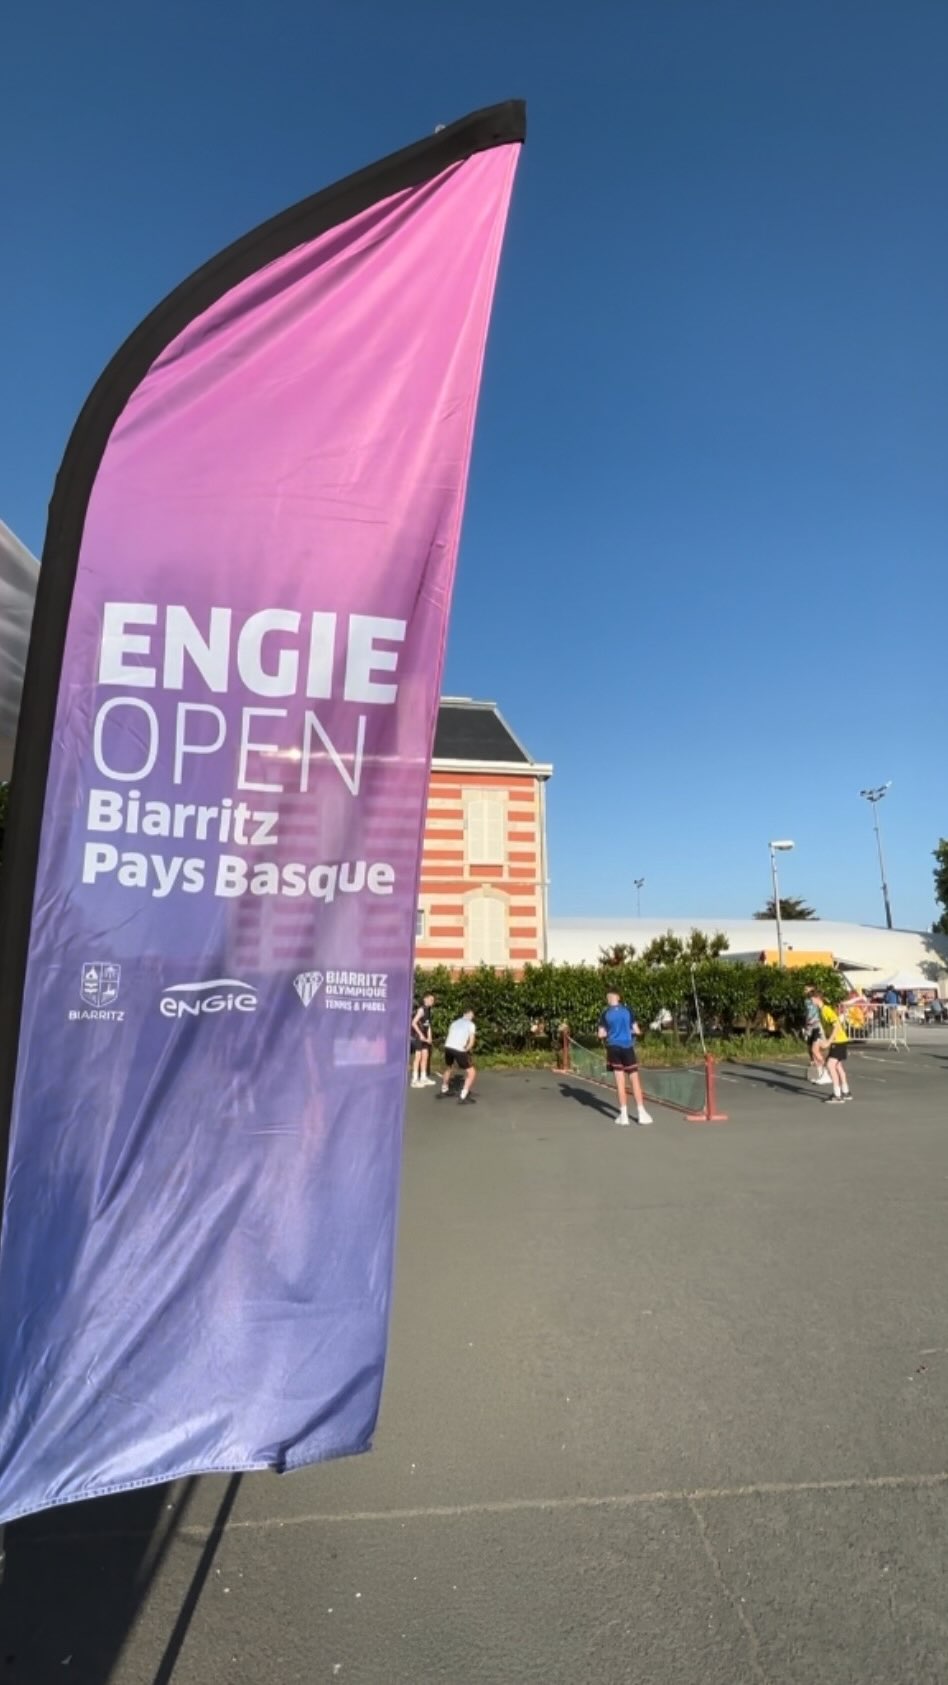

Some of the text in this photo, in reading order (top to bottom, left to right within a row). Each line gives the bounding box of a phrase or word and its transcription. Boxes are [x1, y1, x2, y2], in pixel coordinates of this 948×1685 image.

[99, 602, 406, 704] ENGIE
[93, 696, 367, 796] OPEN
[87, 789, 278, 845] Biarritz
[82, 842, 396, 902] Pays Basque
[325, 970, 388, 987] BIARRITZ
[325, 984, 387, 998] OLYMPIQUE
[68, 1009, 125, 1021] BIARRITZ
[325, 999, 352, 1011] TENNIS
